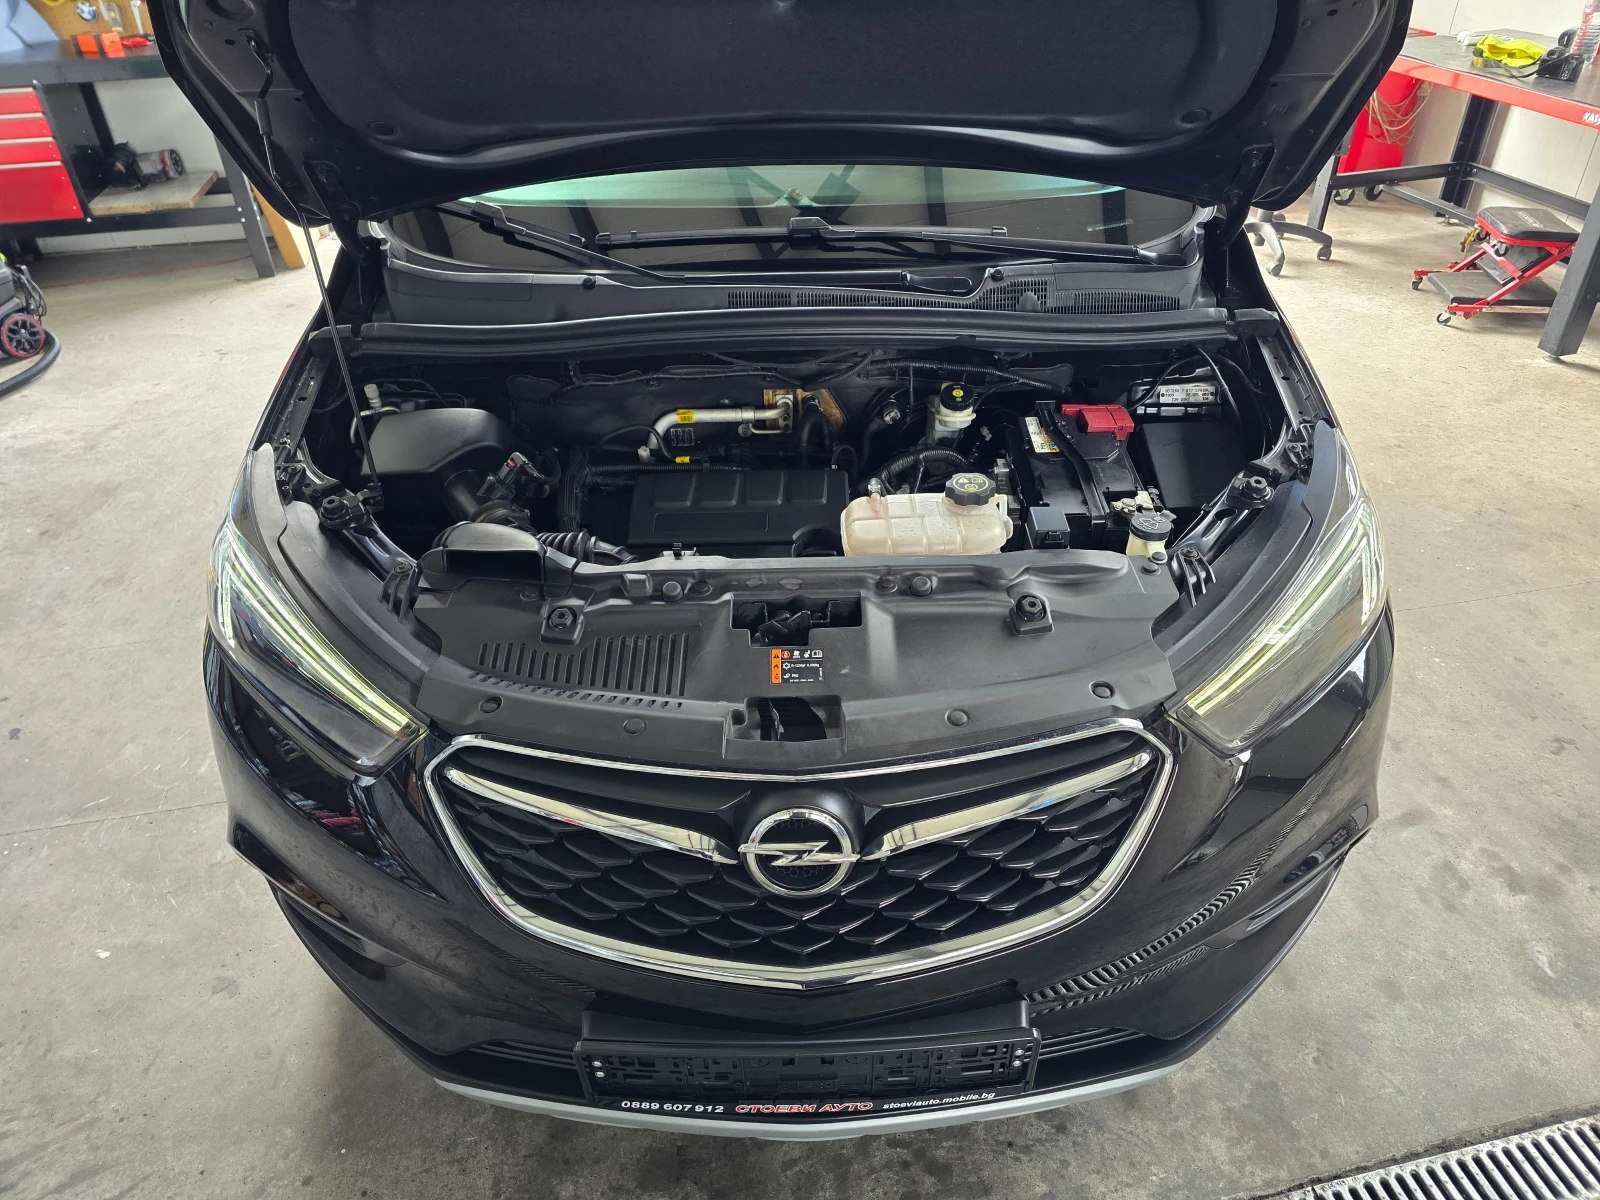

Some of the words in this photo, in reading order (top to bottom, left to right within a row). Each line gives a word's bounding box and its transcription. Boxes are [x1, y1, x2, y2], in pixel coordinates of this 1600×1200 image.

[621, 1101, 660, 1110] 0889
[663, 1103, 692, 1112] 607
[694, 1105, 724, 1113] 912
[882, 1092, 996, 1110] stoeviauto.mobile.bg
[735, 1104, 816, 1114] СТОЕВИ
[818, 1102, 874, 1113] АУТО
